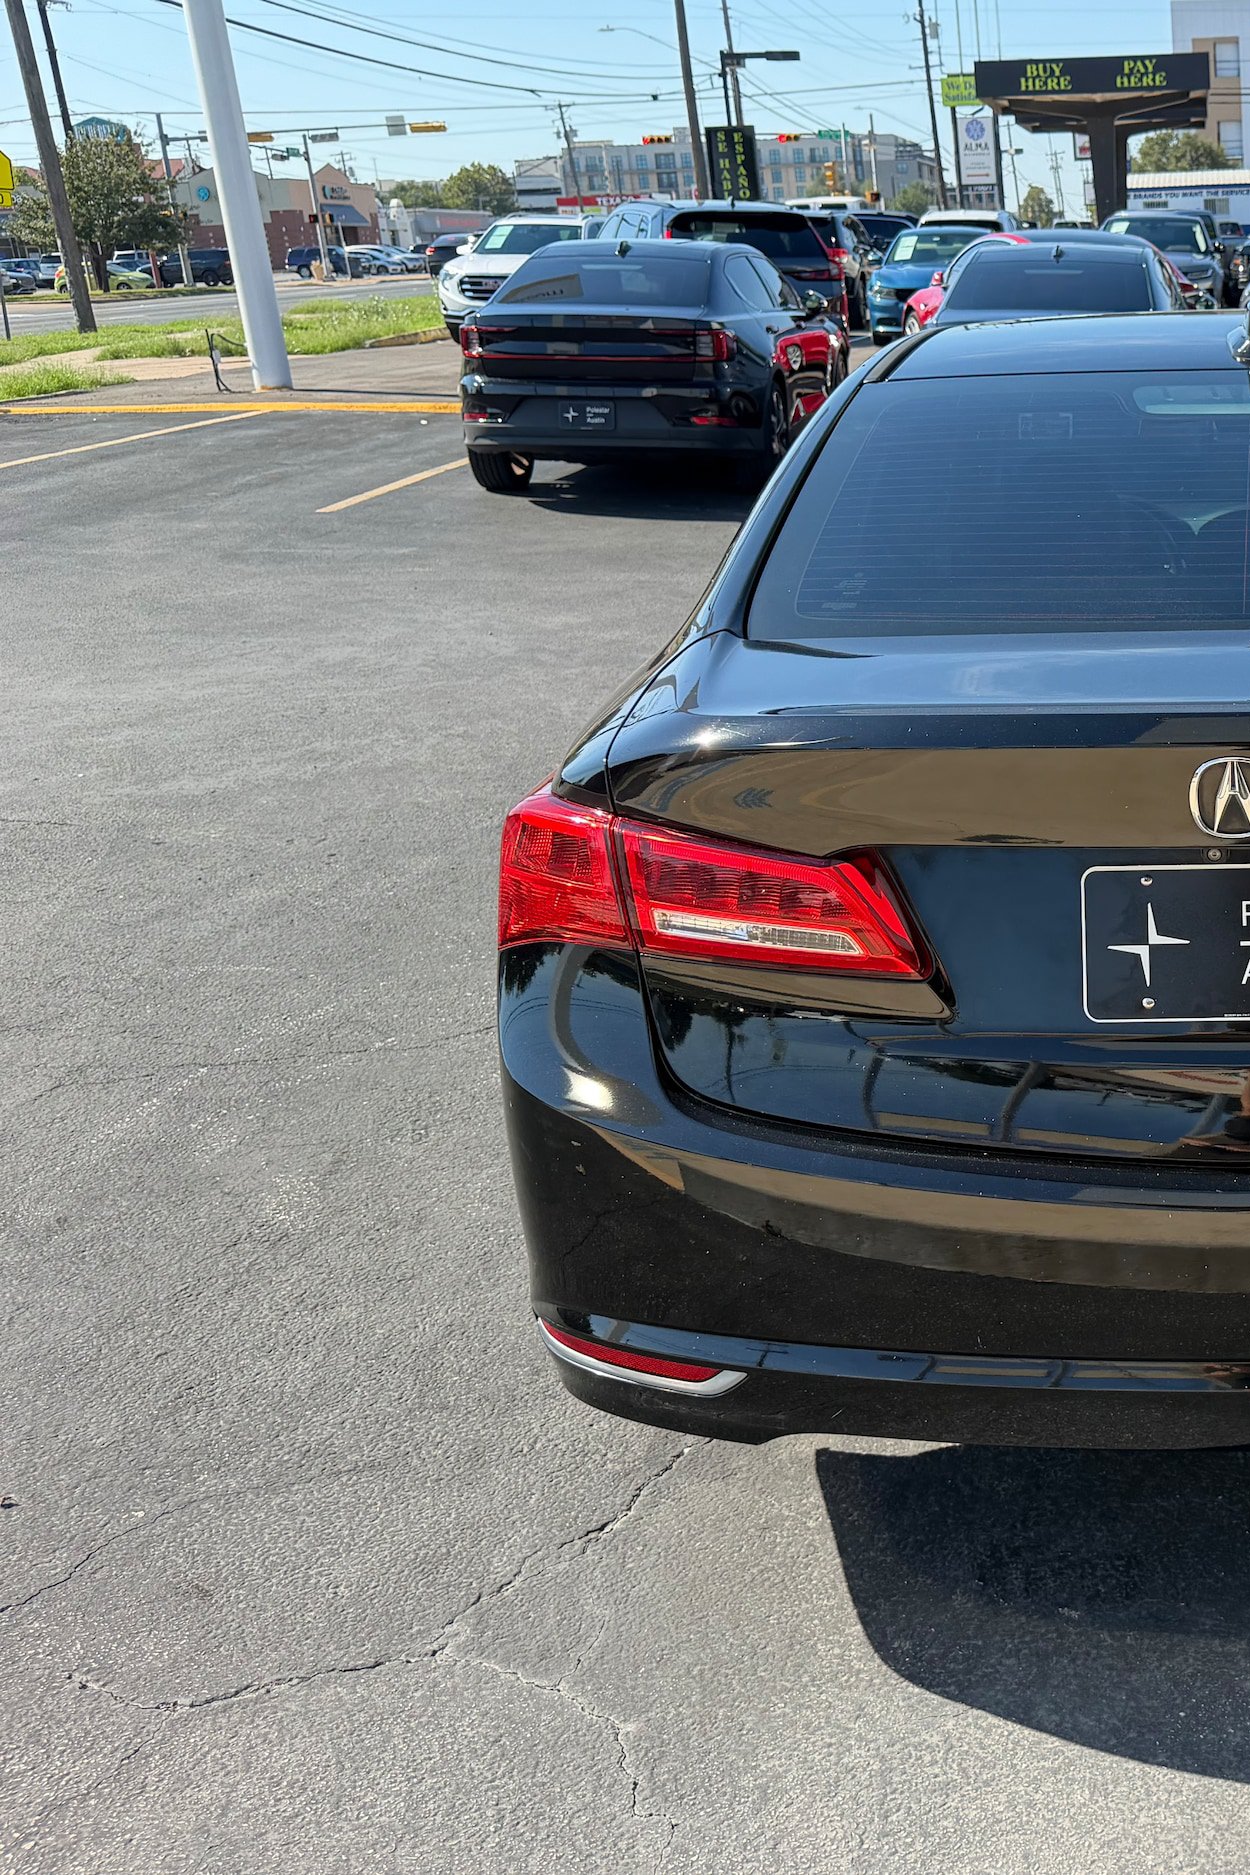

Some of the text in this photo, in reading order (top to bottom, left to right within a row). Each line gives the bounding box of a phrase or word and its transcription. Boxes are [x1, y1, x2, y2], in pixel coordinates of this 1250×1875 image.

[1026, 62, 1064, 77] BUY
[1123, 58, 1157, 74] PAY
[1020, 75, 1072, 91] HERE
[1115, 72, 1167, 88] HERE
[964, 142, 990, 151] ALMA
[716, 130, 733, 200] SE HABL
[733, 131, 751, 199] ESPAÑO
